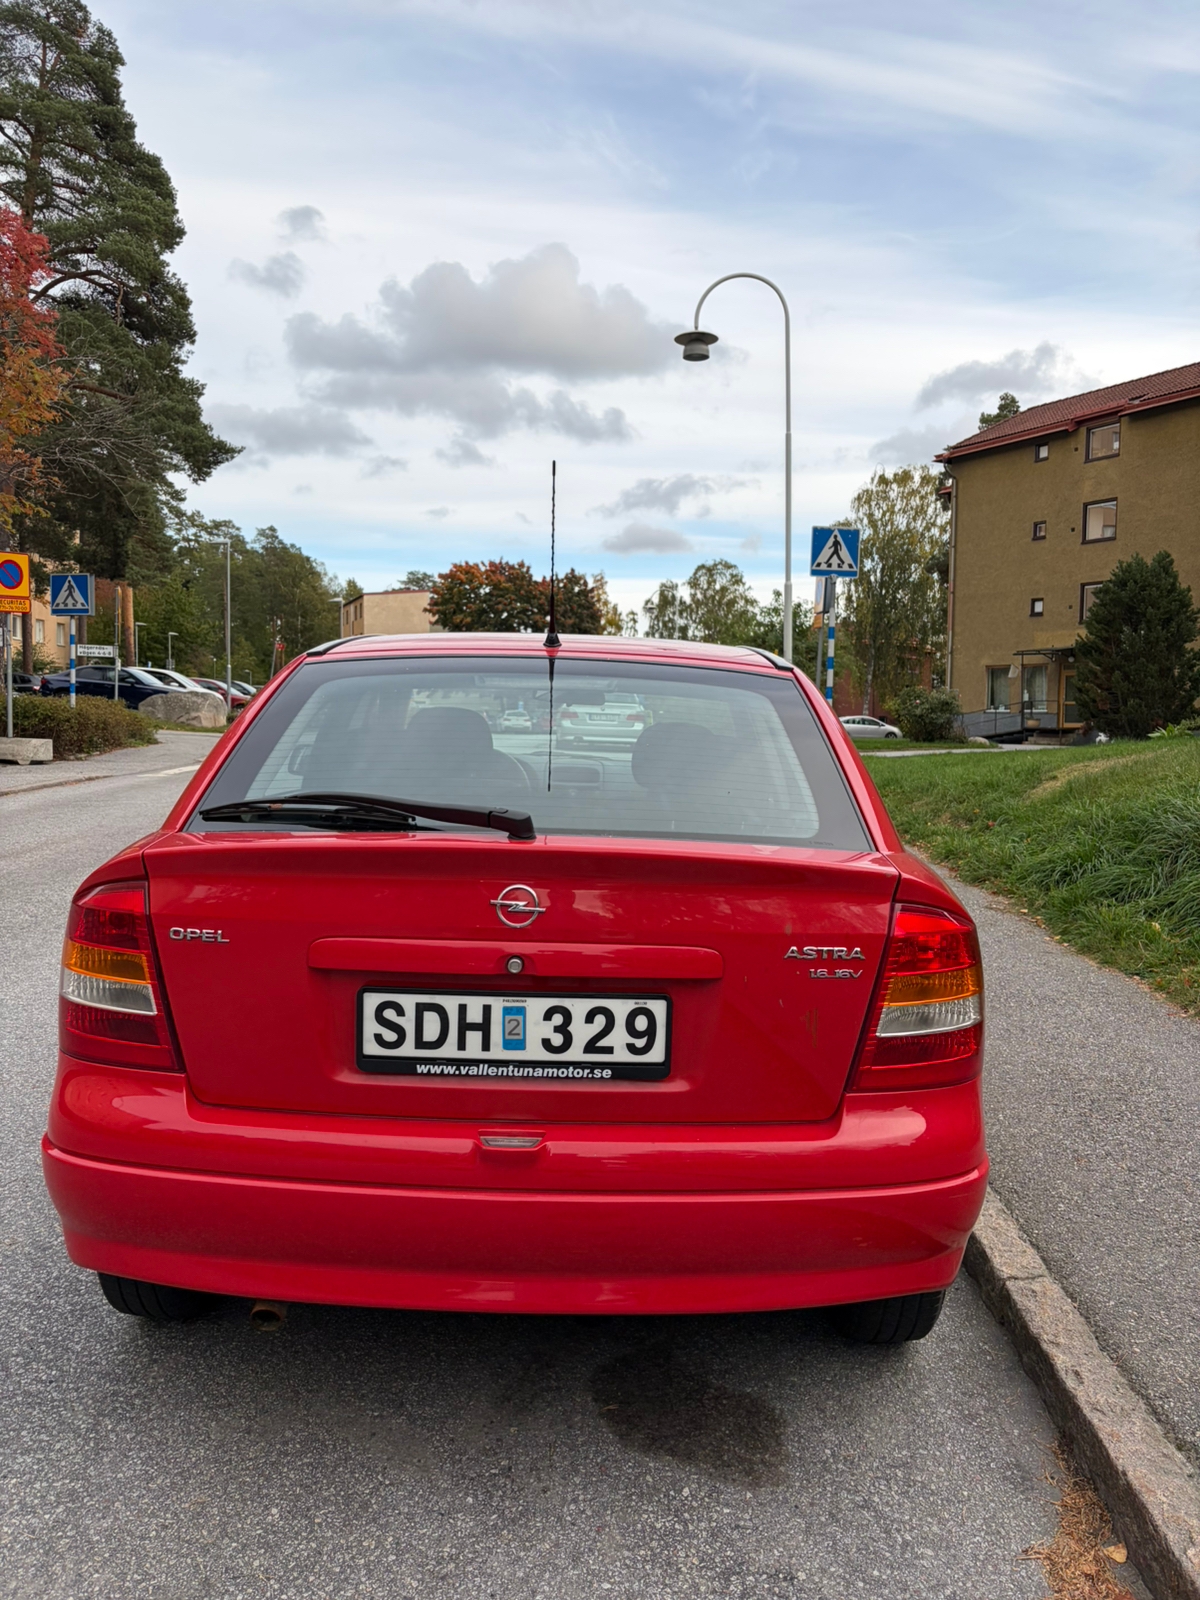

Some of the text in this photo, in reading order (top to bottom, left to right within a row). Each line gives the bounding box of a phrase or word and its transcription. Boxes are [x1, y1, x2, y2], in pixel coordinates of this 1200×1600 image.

[169, 926, 230, 943] OPEL
[784, 946, 866, 961] ASTRA
[373, 1000, 658, 1056] SDH 329
[507, 1018, 521, 1036] 2
[416, 1063, 613, 1079] www.vallentunamotor.se
